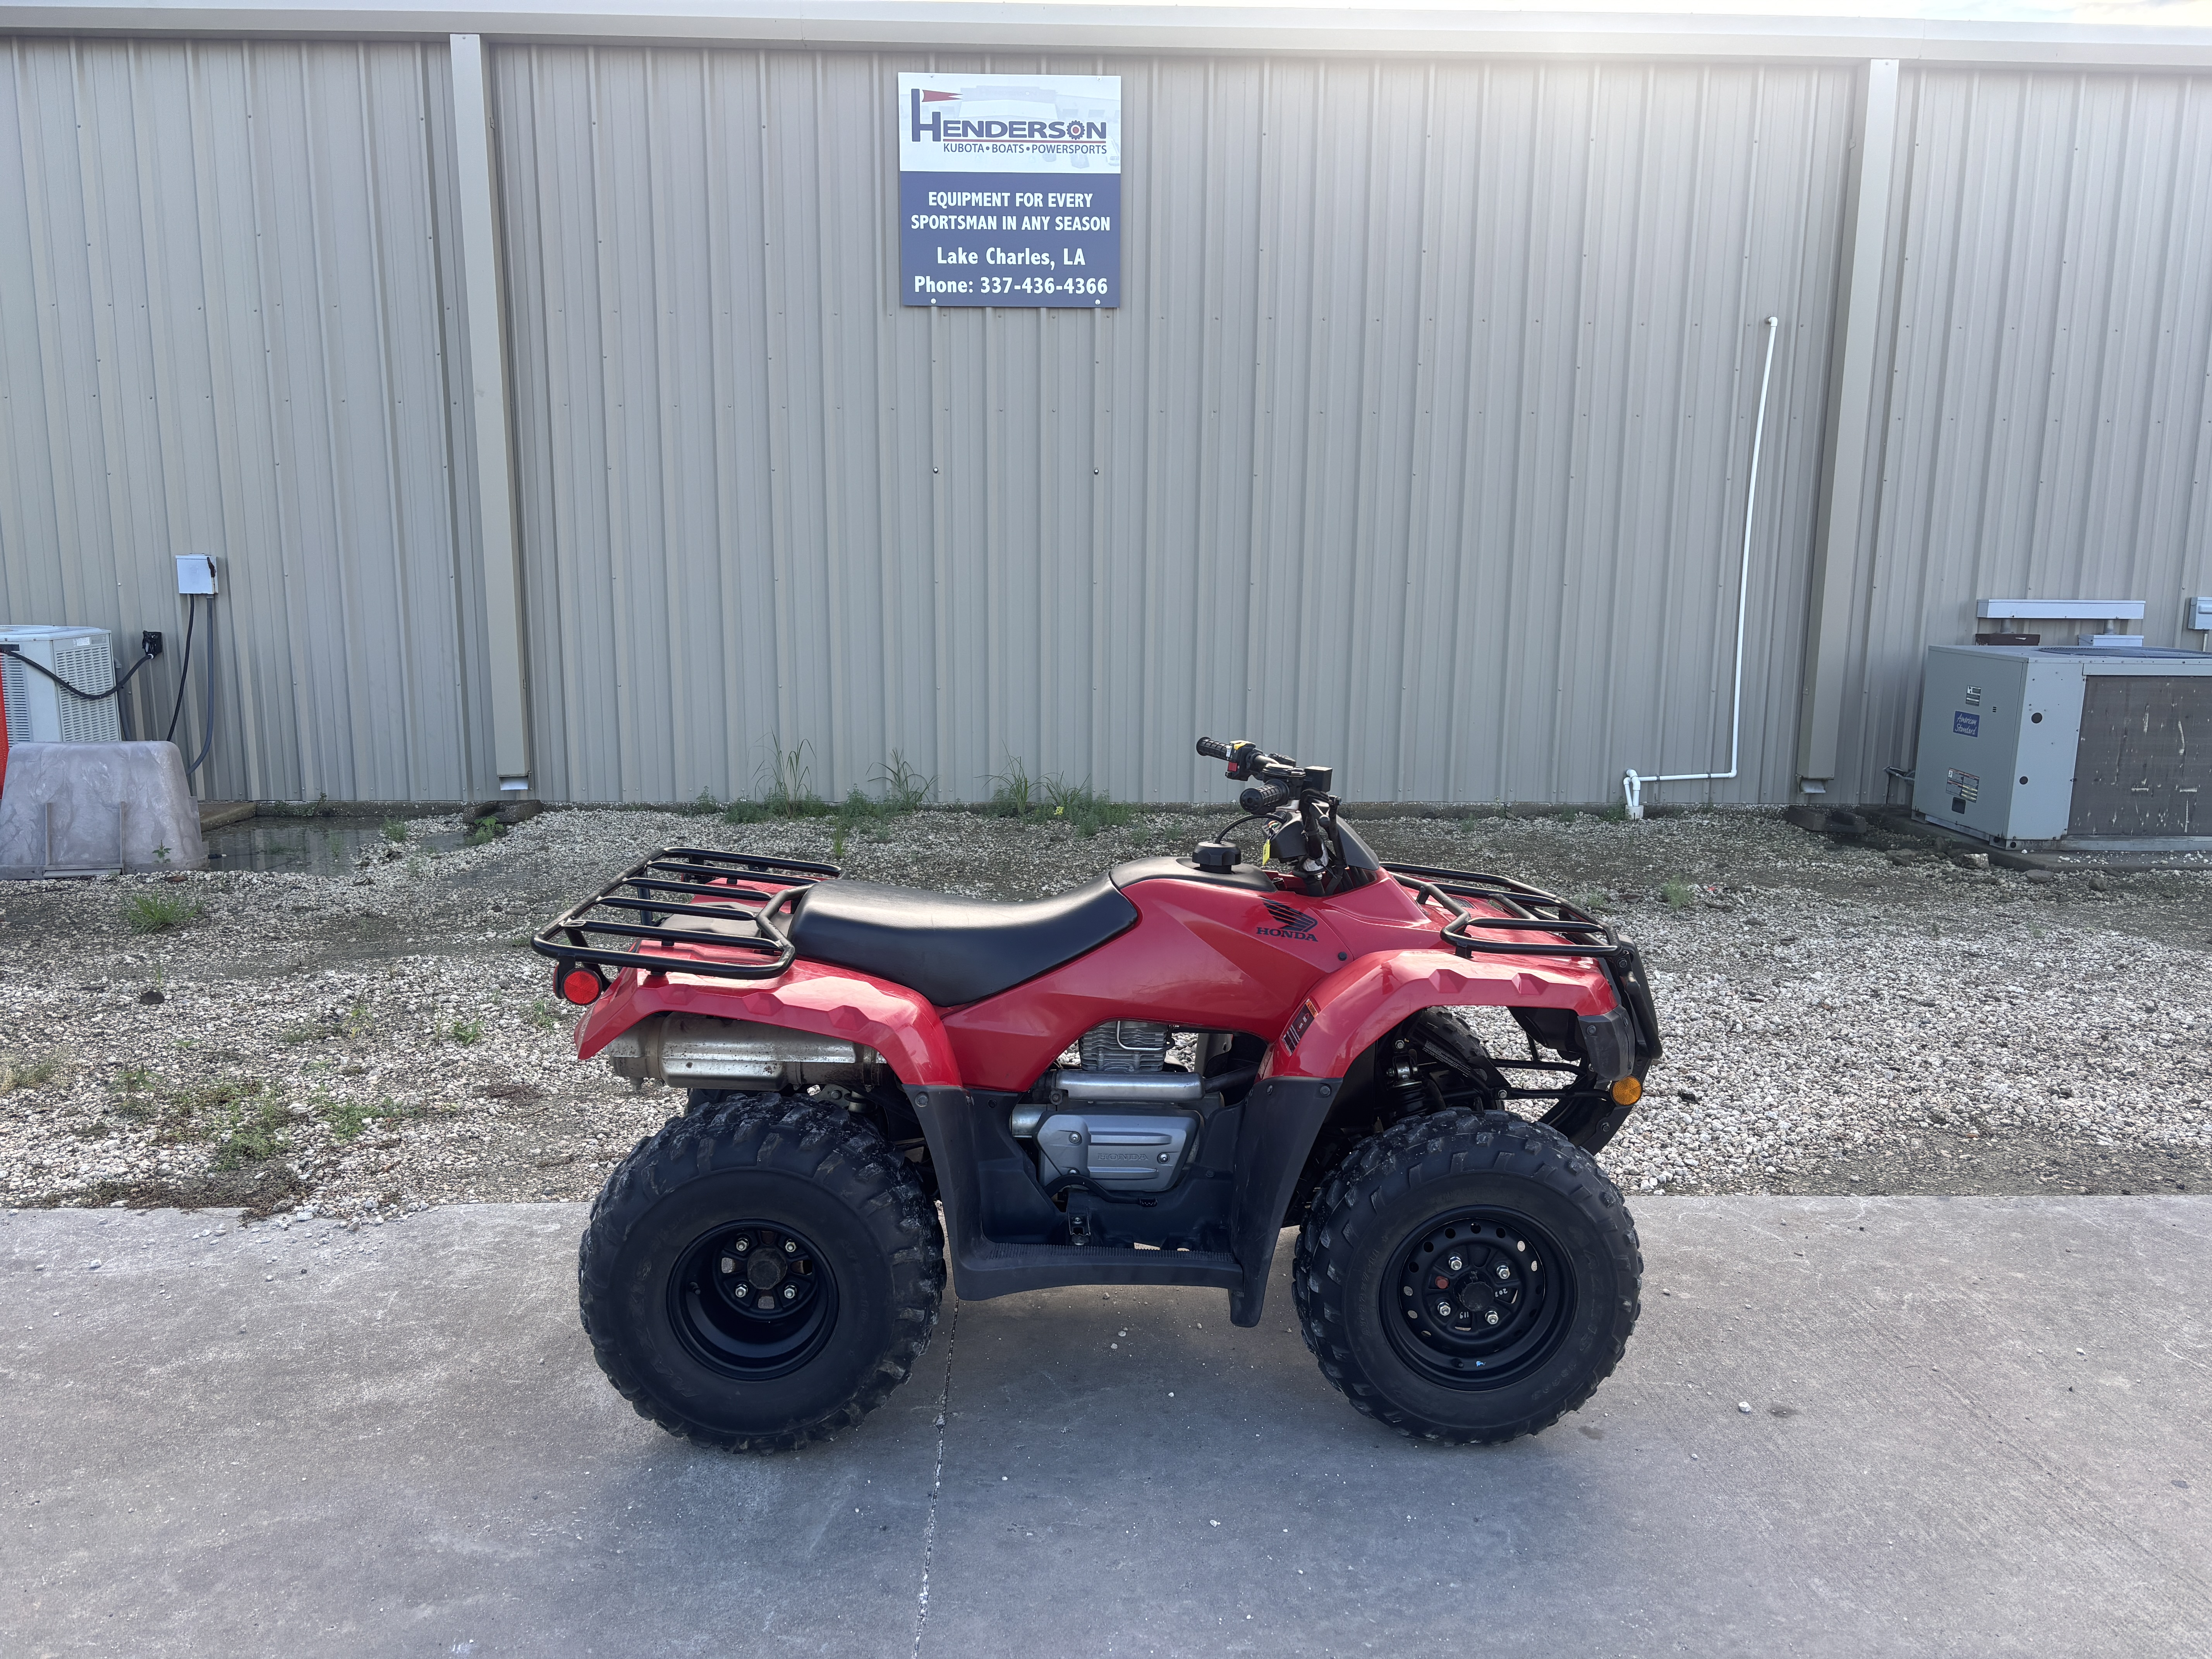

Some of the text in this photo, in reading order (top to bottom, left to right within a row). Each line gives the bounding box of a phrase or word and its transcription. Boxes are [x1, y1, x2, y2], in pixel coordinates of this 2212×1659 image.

[911, 88, 1107, 142] HENDERSON
[943, 143, 1108, 155] KUBOTA BOATS POWERSPORTS
[928, 191, 1093, 209] EQUIPMENT FOR EVERY
[910, 215, 1110, 231] SPORTSMAN IN ANY SEASON
[937, 246, 1086, 271] Lake Charles, LA
[914, 275, 1108, 295] Phone: 337-436-4366
[1256, 927, 1319, 942] HONDA
